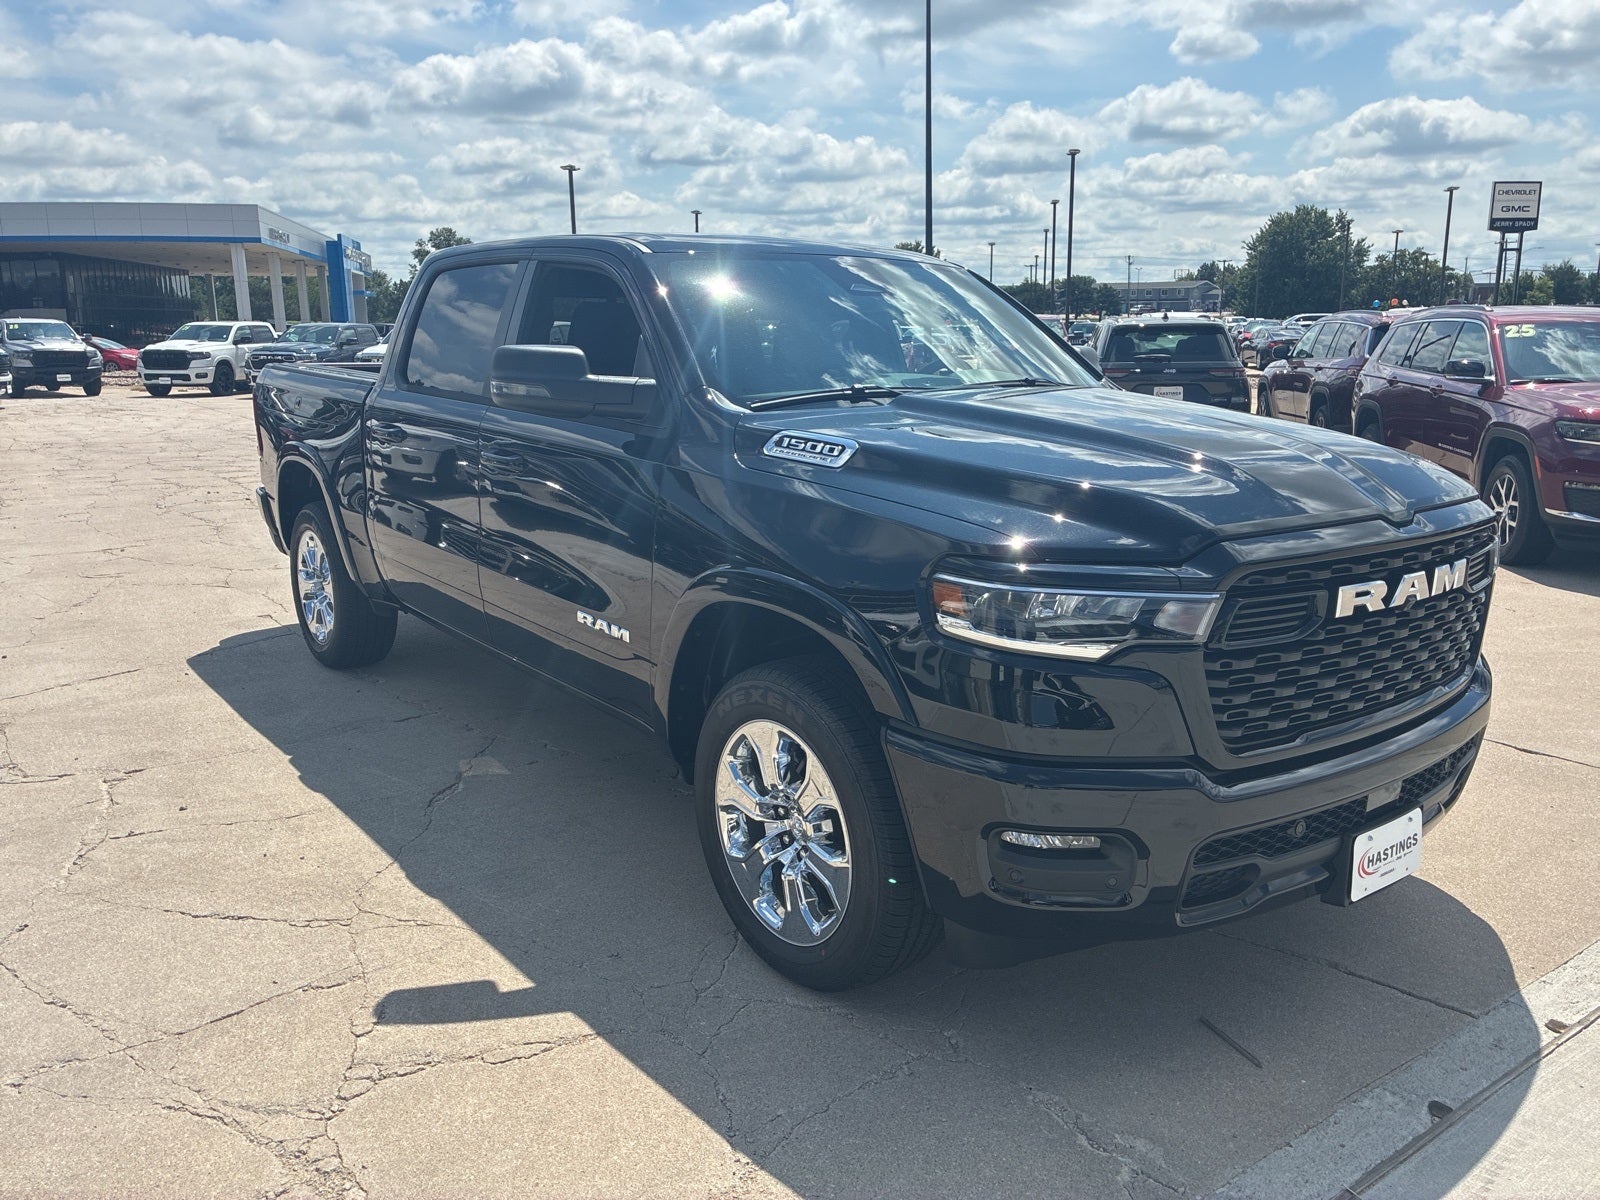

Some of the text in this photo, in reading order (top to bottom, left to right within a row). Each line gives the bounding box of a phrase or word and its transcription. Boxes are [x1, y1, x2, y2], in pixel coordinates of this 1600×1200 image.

[1501, 205, 1531, 213] GMC
[1504, 324, 1536, 338] 25
[781, 437, 842, 457] 1500
[1335, 558, 1467, 618] RAM
[576, 610, 630, 643] RAM
[1367, 833, 1418, 869] HASTINGS
